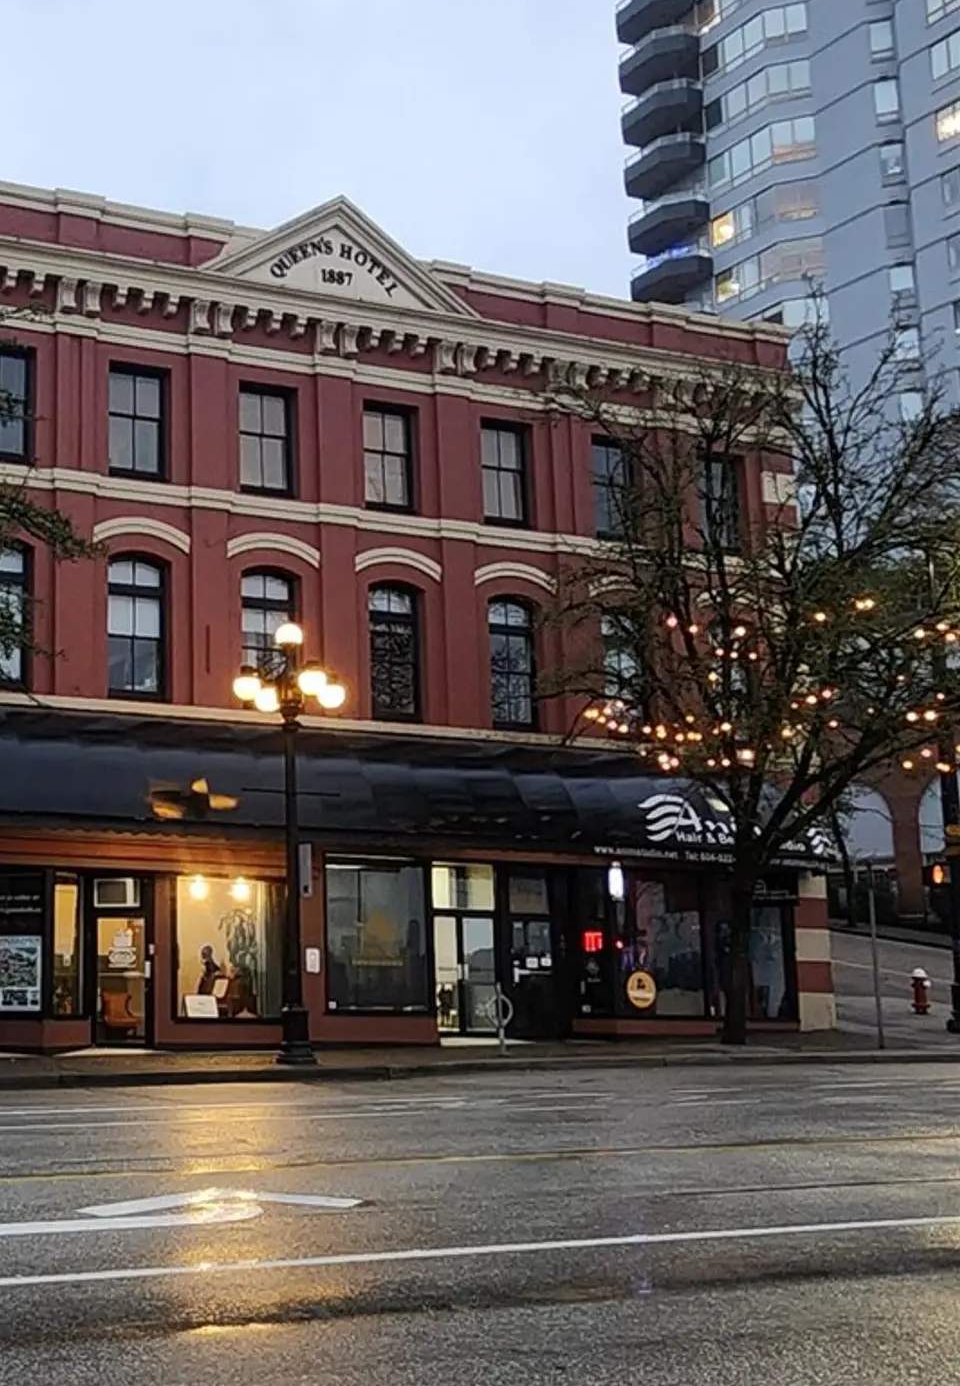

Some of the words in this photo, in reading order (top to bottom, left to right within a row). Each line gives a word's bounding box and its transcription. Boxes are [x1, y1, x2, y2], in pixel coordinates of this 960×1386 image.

[270, 237, 334, 278] QUEEN'S
[340, 243, 398, 298] HOTEL
[321, 269, 353, 286] 1887
[676, 831, 702, 843] Hair
[707, 832, 717, 843] &
